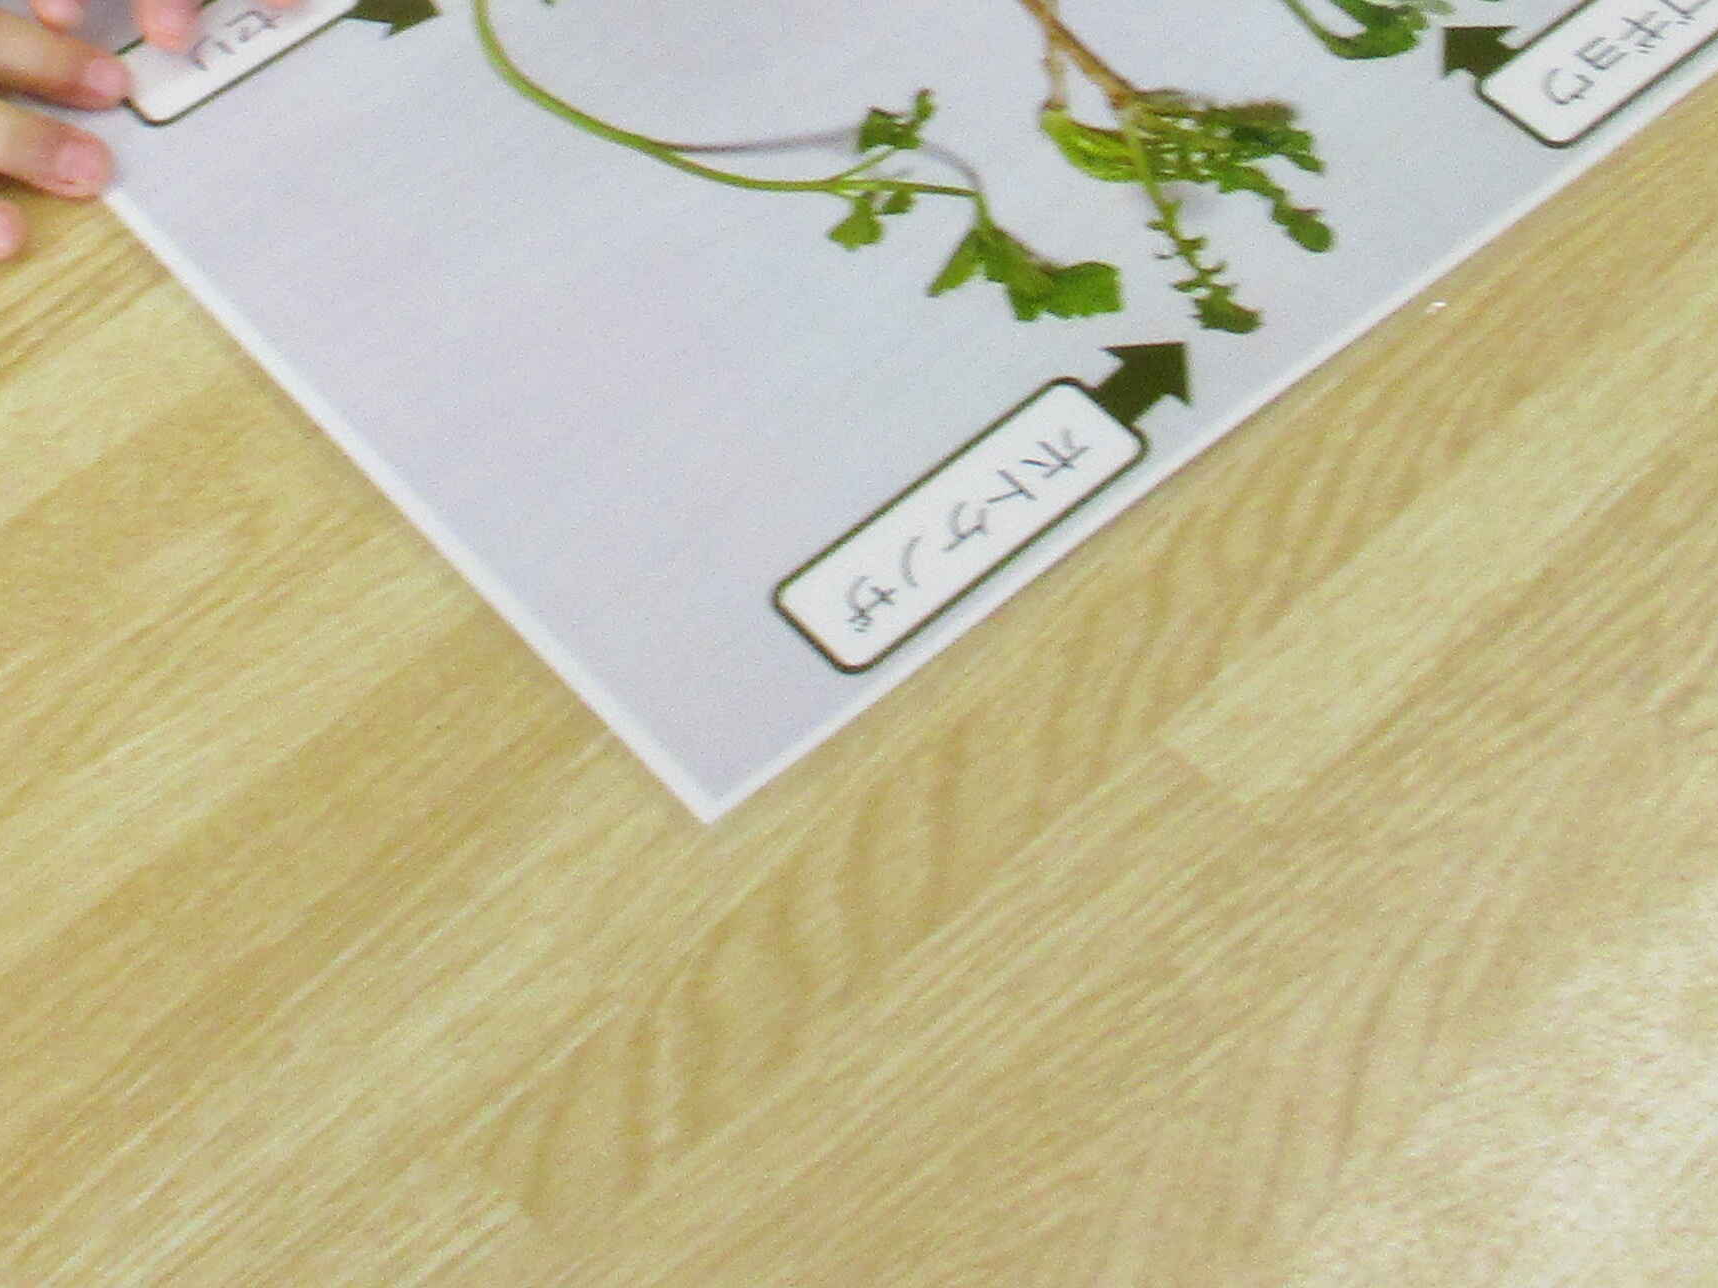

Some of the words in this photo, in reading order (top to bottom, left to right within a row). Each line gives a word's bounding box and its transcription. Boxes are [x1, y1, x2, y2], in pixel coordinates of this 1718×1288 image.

[846, 428, 1093, 635] ホトケノザ
